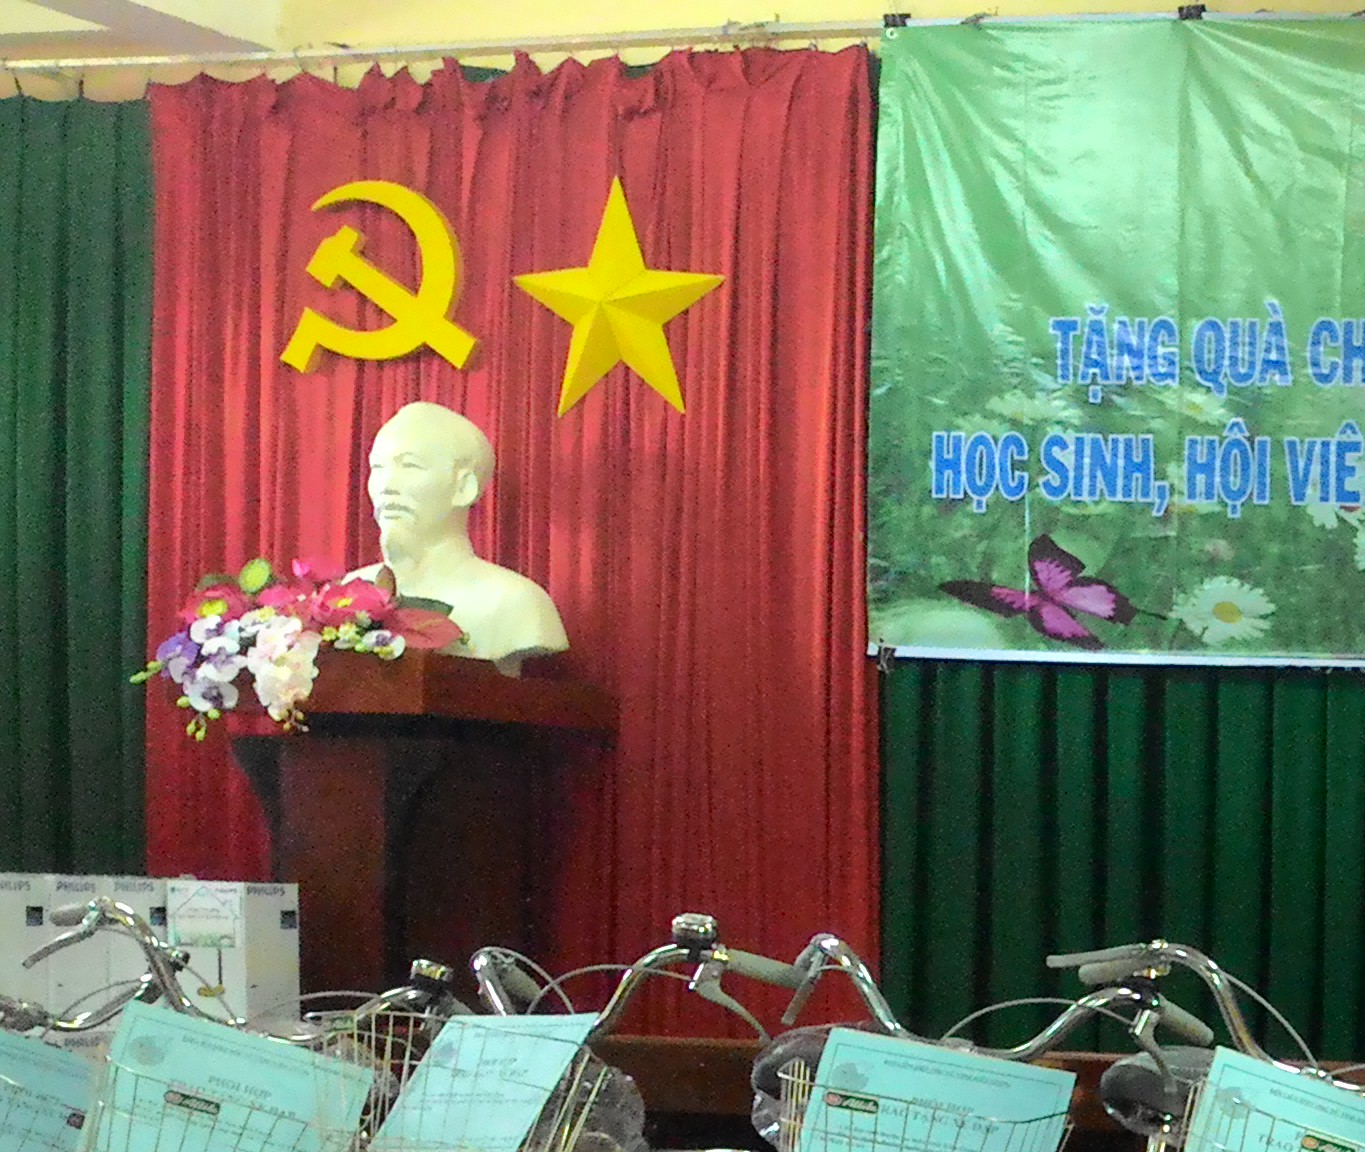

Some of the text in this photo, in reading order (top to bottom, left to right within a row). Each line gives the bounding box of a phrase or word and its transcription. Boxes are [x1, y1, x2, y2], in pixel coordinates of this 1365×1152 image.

[1049, 302, 1180, 403] TẶNG
[1191, 300, 1291, 396] QUÀ
[931, 431, 1028, 513] HỌC
[1039, 432, 1169, 516] SINH,
[1185, 418, 1272, 518] HỘI
